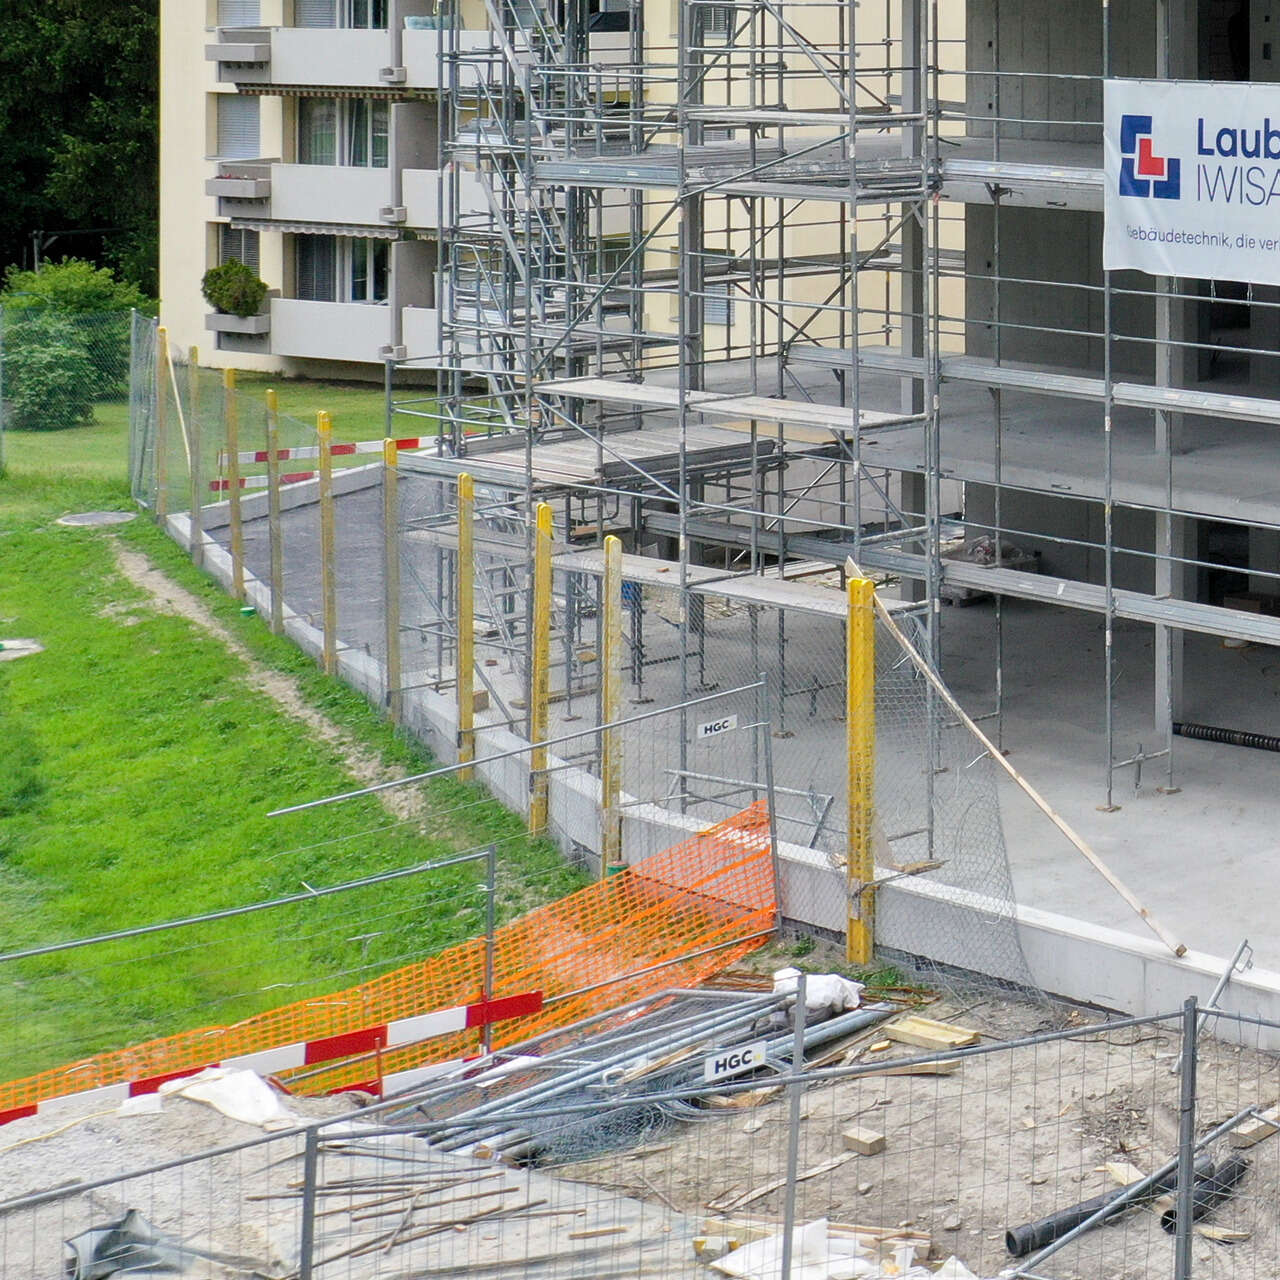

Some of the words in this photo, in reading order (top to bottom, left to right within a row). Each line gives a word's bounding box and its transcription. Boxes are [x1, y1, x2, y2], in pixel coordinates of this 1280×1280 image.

[1235, 233, 1256, 249] die
[704, 720, 729, 735] HGC
[714, 1049, 753, 1075] HGC
